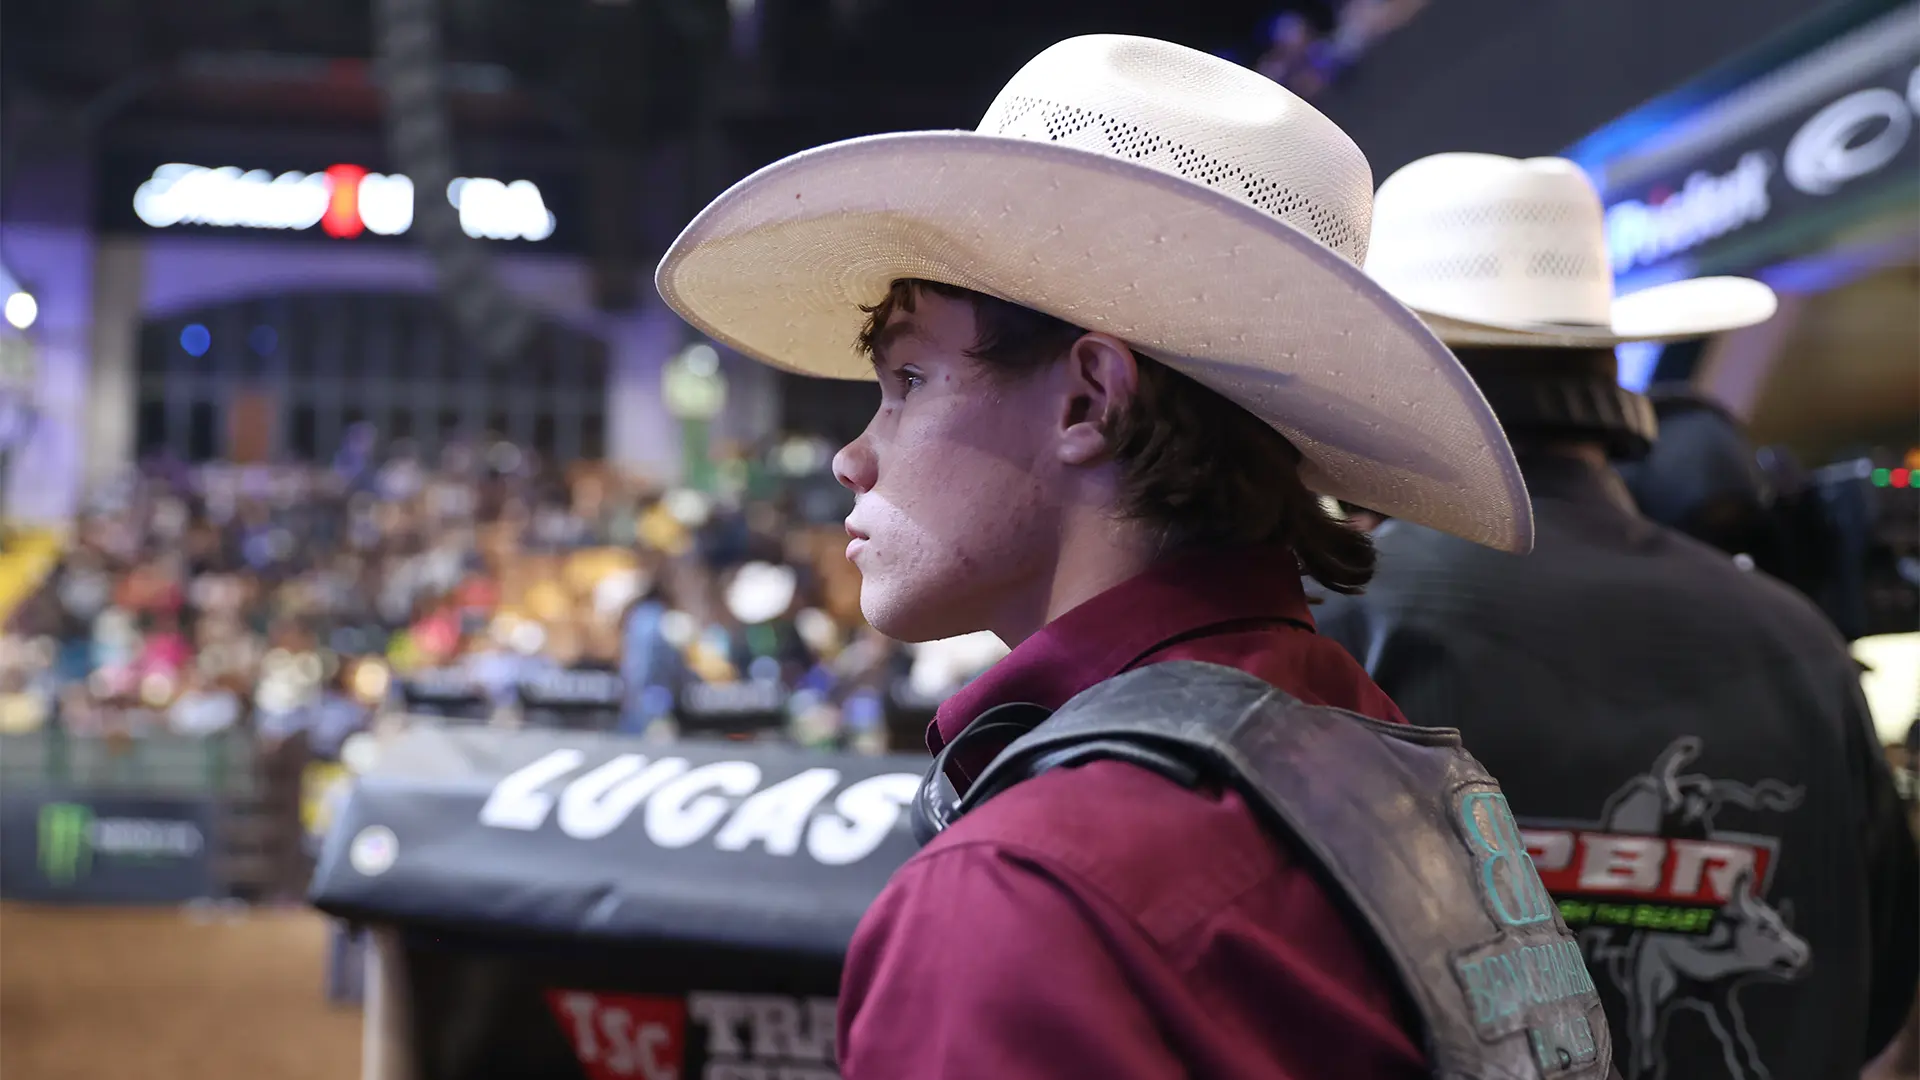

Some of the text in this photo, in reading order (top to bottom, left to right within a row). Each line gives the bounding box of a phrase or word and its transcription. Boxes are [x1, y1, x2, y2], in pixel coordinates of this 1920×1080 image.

[479, 748, 924, 866] LUCAS
[560, 989, 841, 1080] TSC TRA
